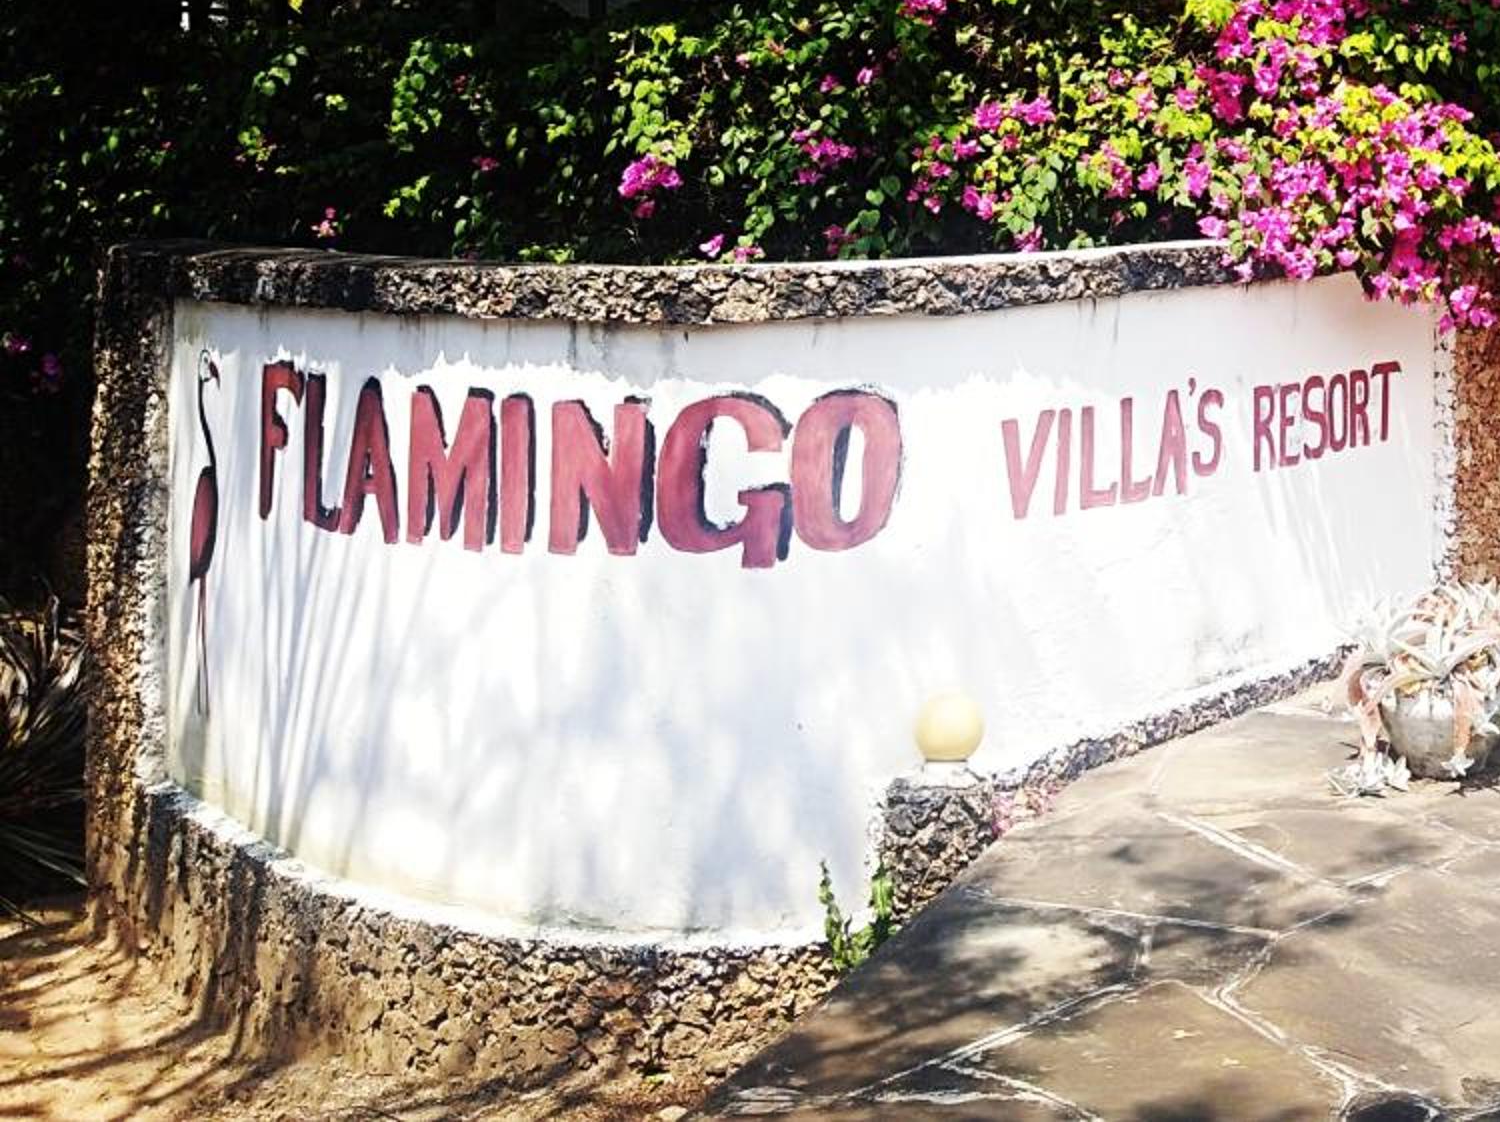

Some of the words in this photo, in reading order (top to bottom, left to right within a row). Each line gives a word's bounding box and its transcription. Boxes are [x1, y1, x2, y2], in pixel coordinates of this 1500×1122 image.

[260, 360, 902, 569] FLAMINGO
[1001, 378, 1225, 520] VILLA'S
[1252, 360, 1402, 472] RESORT
